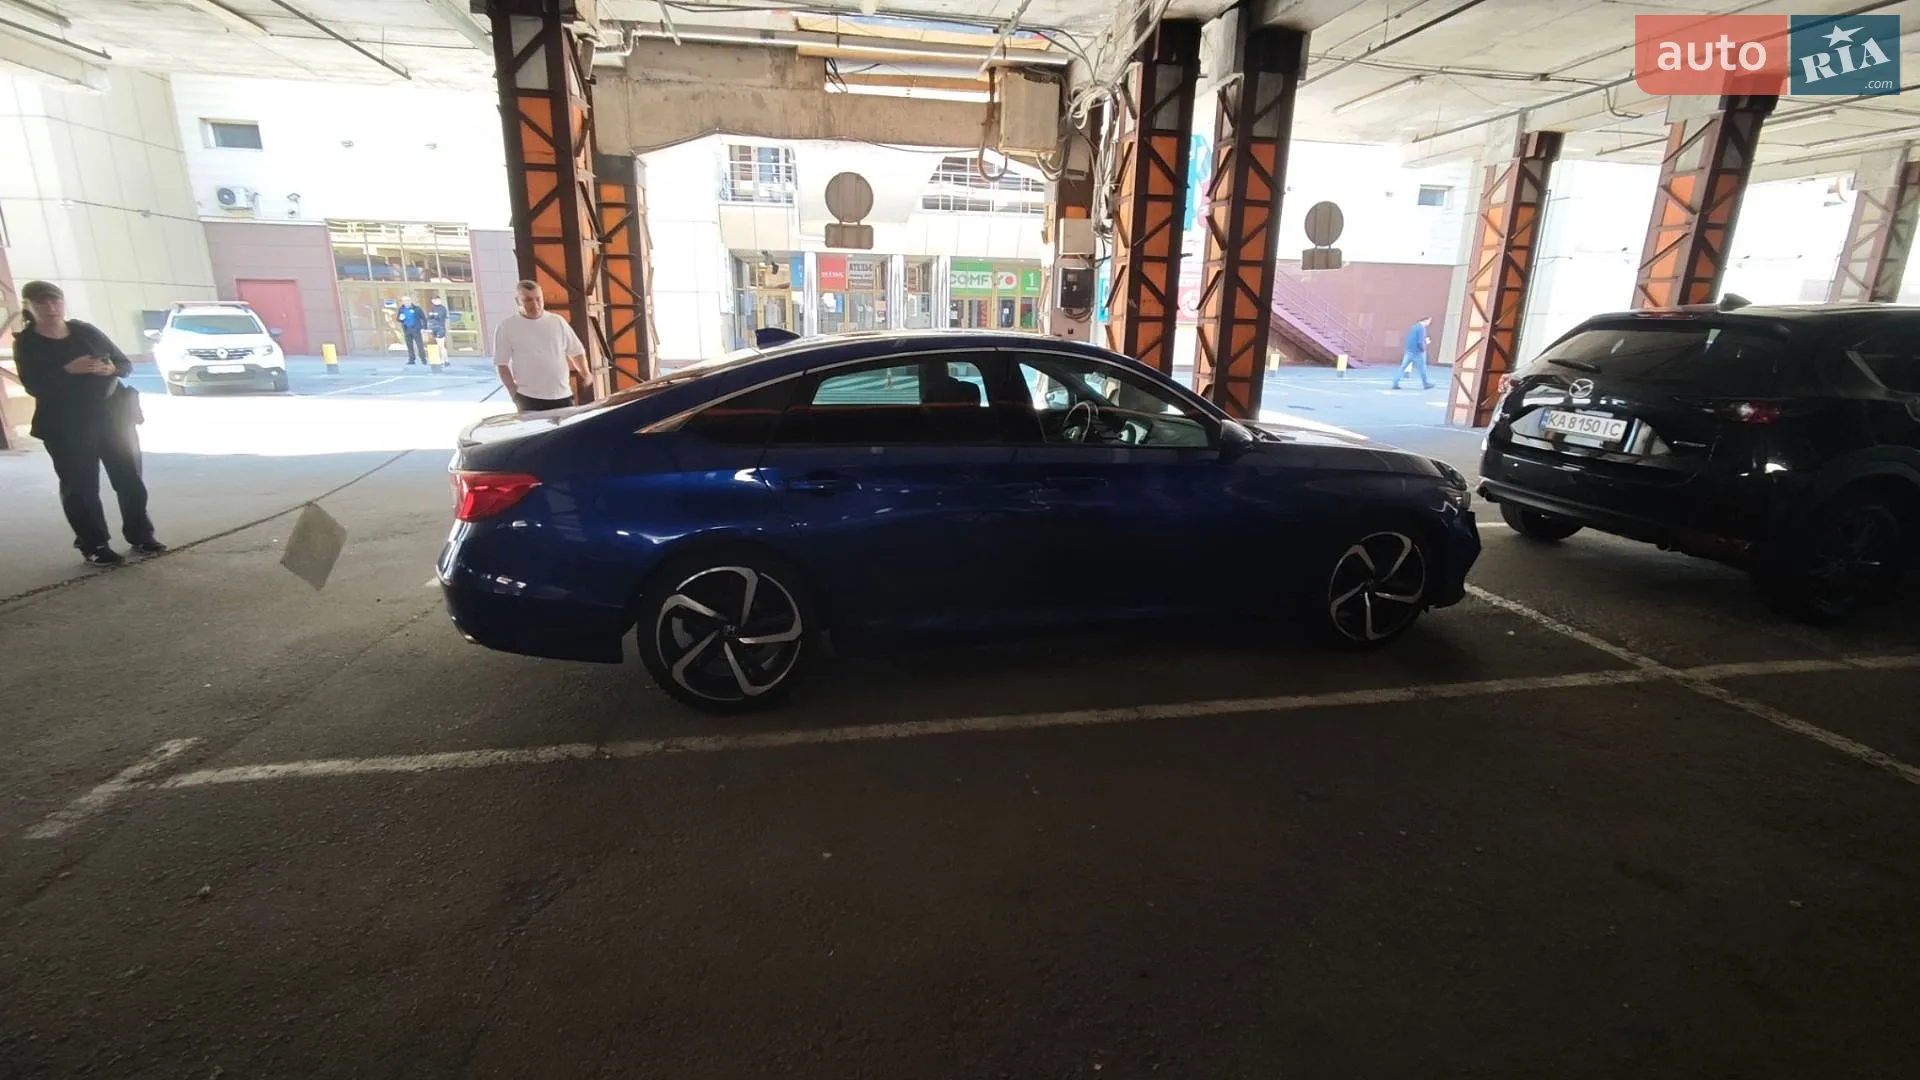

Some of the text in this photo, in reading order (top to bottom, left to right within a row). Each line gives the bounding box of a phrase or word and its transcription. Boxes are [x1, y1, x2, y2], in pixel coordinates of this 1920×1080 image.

[1028, 272, 1035, 287] 1
[1550, 413, 1567, 427] KA
[1568, 416, 1601, 433] 8150
[1603, 421, 1622, 437] IC
